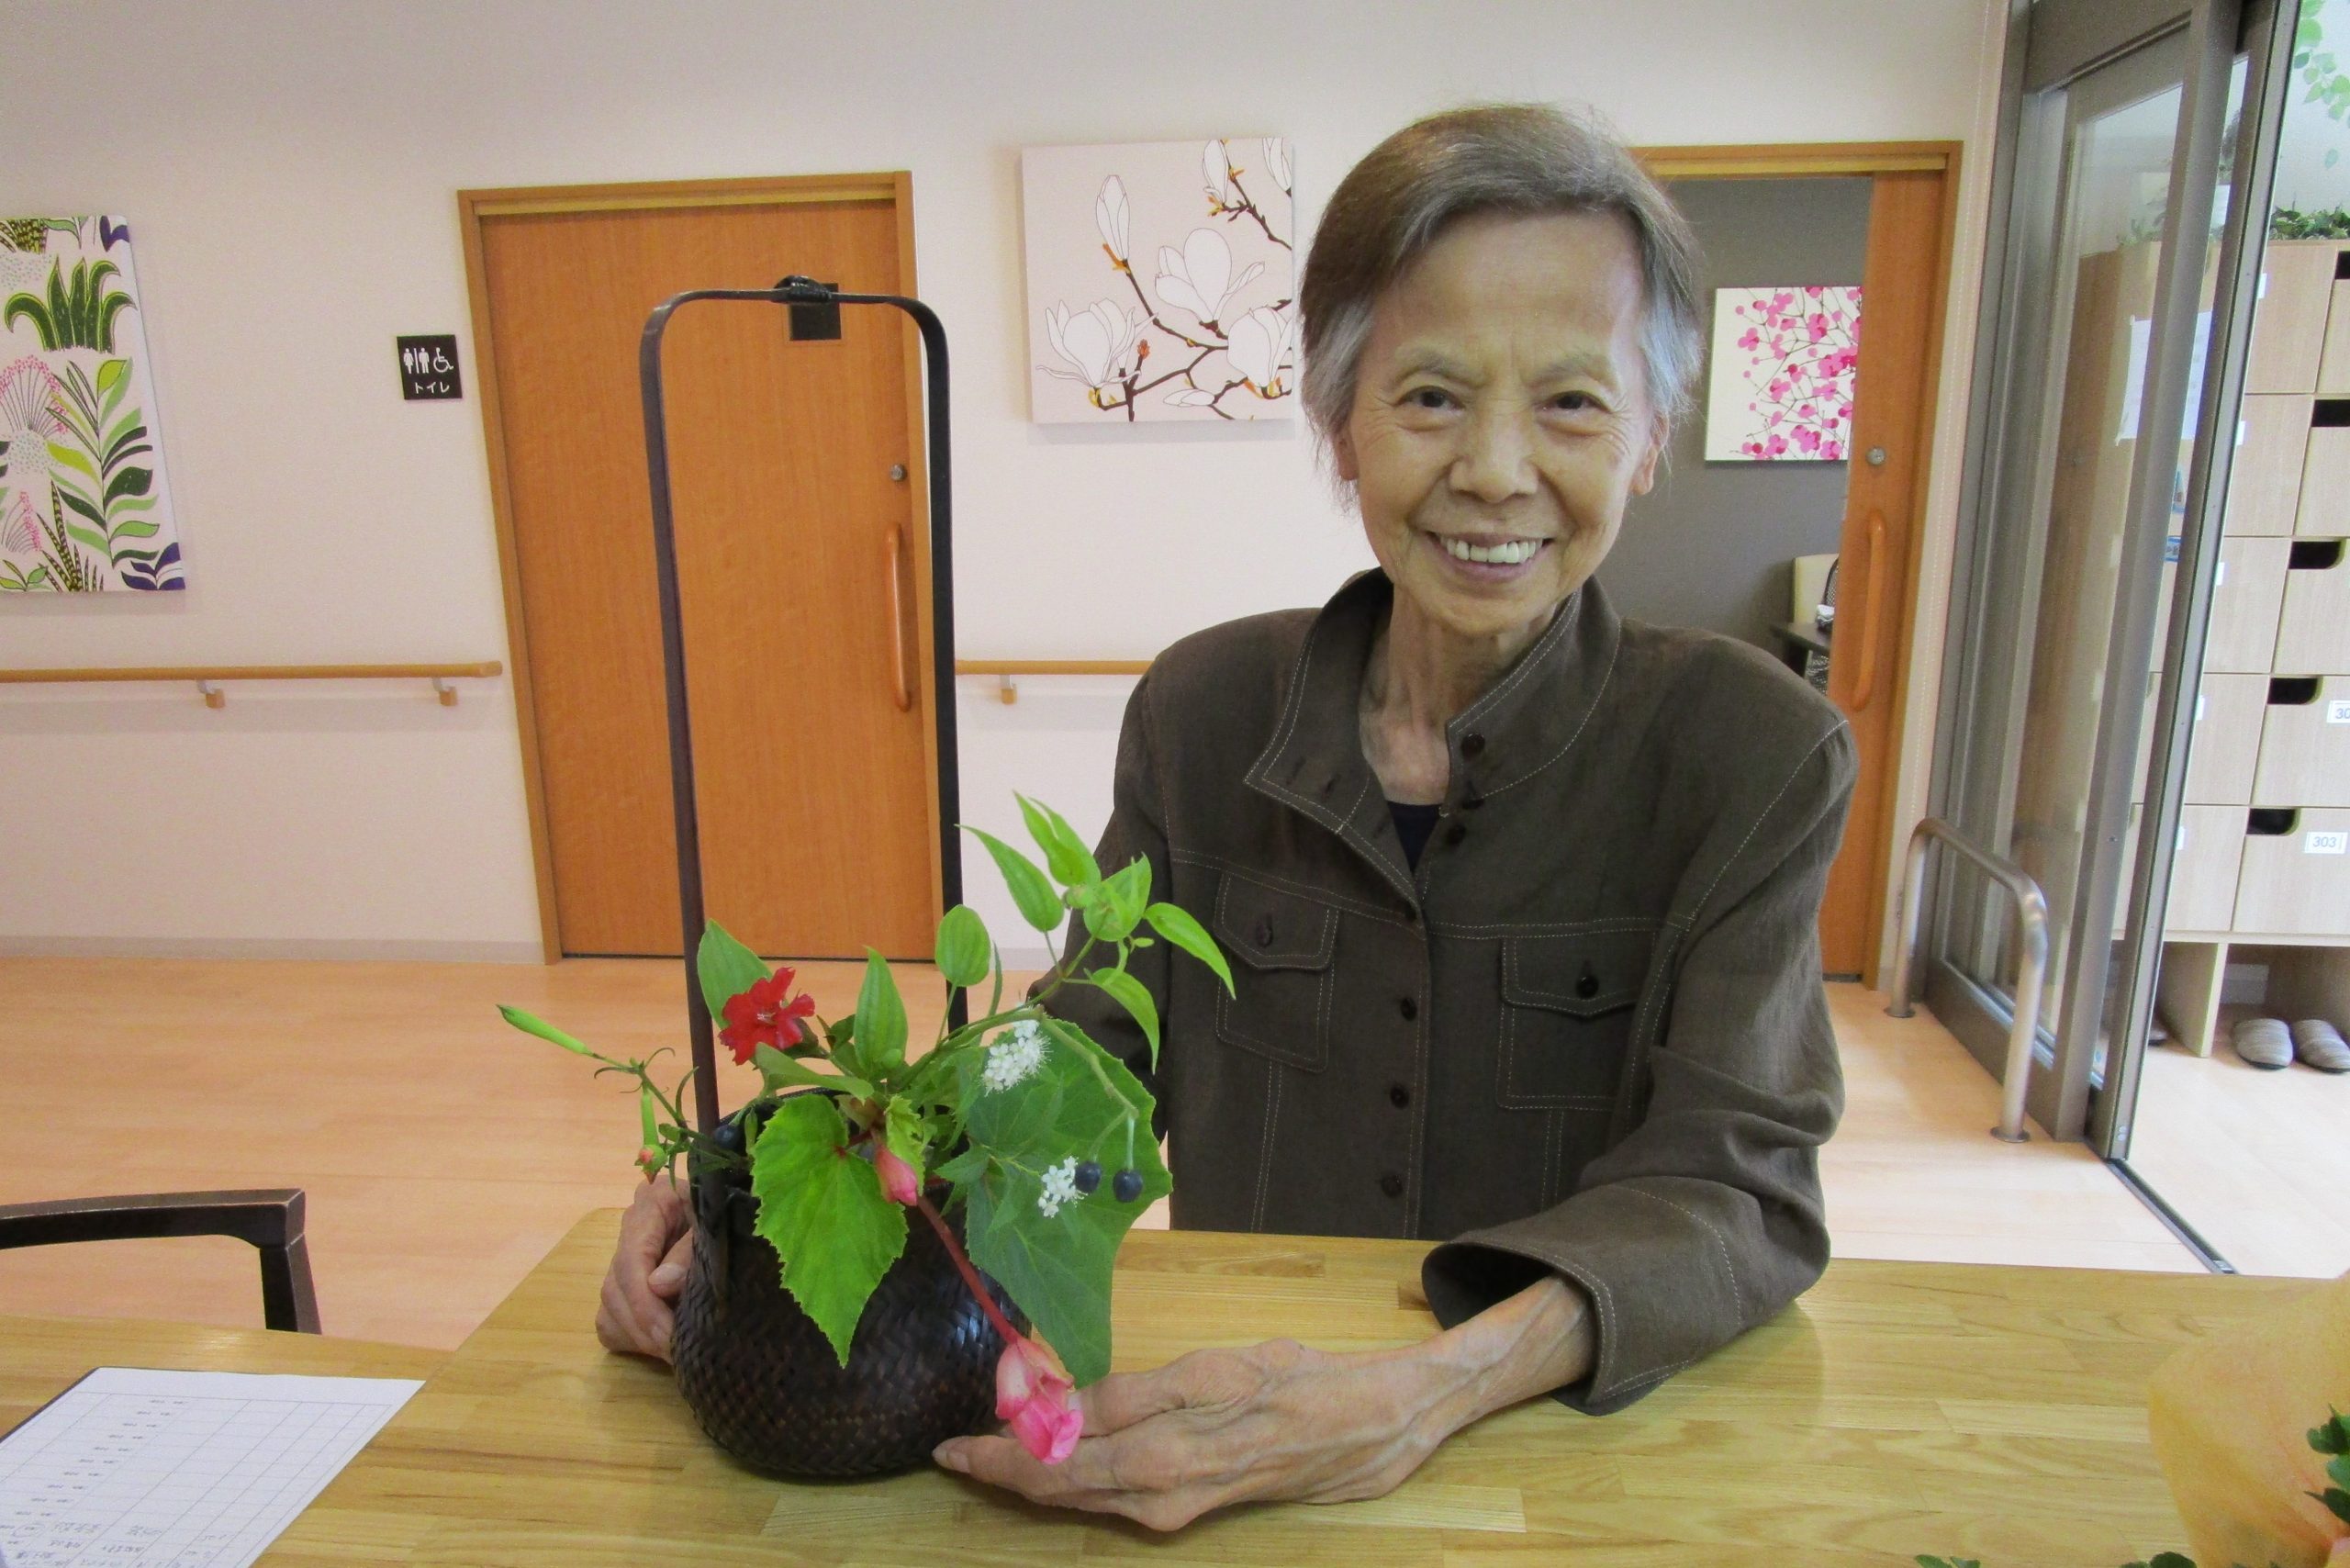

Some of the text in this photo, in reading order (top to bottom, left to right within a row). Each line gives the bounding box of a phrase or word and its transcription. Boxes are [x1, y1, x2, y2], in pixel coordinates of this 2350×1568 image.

[415, 381, 450, 394] トイレ
[2312, 836, 2337, 848] 303
